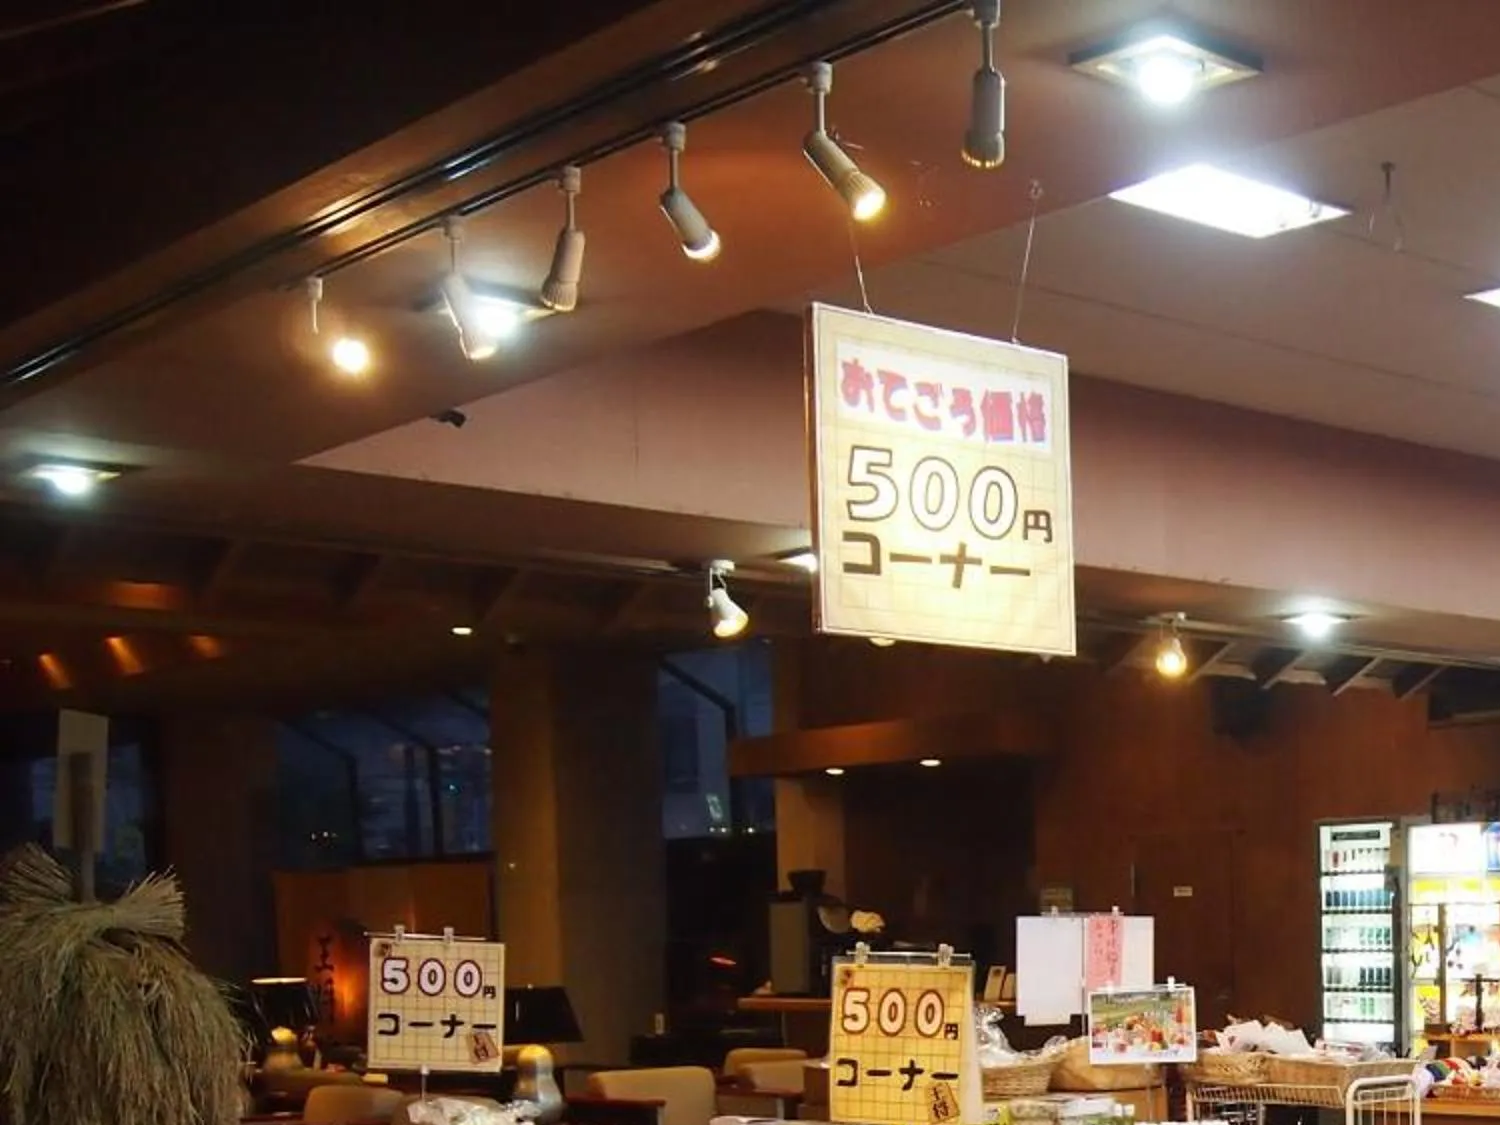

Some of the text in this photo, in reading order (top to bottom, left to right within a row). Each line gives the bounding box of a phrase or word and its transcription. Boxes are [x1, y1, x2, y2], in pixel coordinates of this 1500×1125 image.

[846, 444, 1053, 543] 500円
[842, 531, 1031, 589] コーナー
[381, 957, 497, 1000] 500円
[377, 1012, 497, 1039] コーナー
[841, 987, 959, 1041] 500円
[836, 1057, 959, 1091] コーナー
